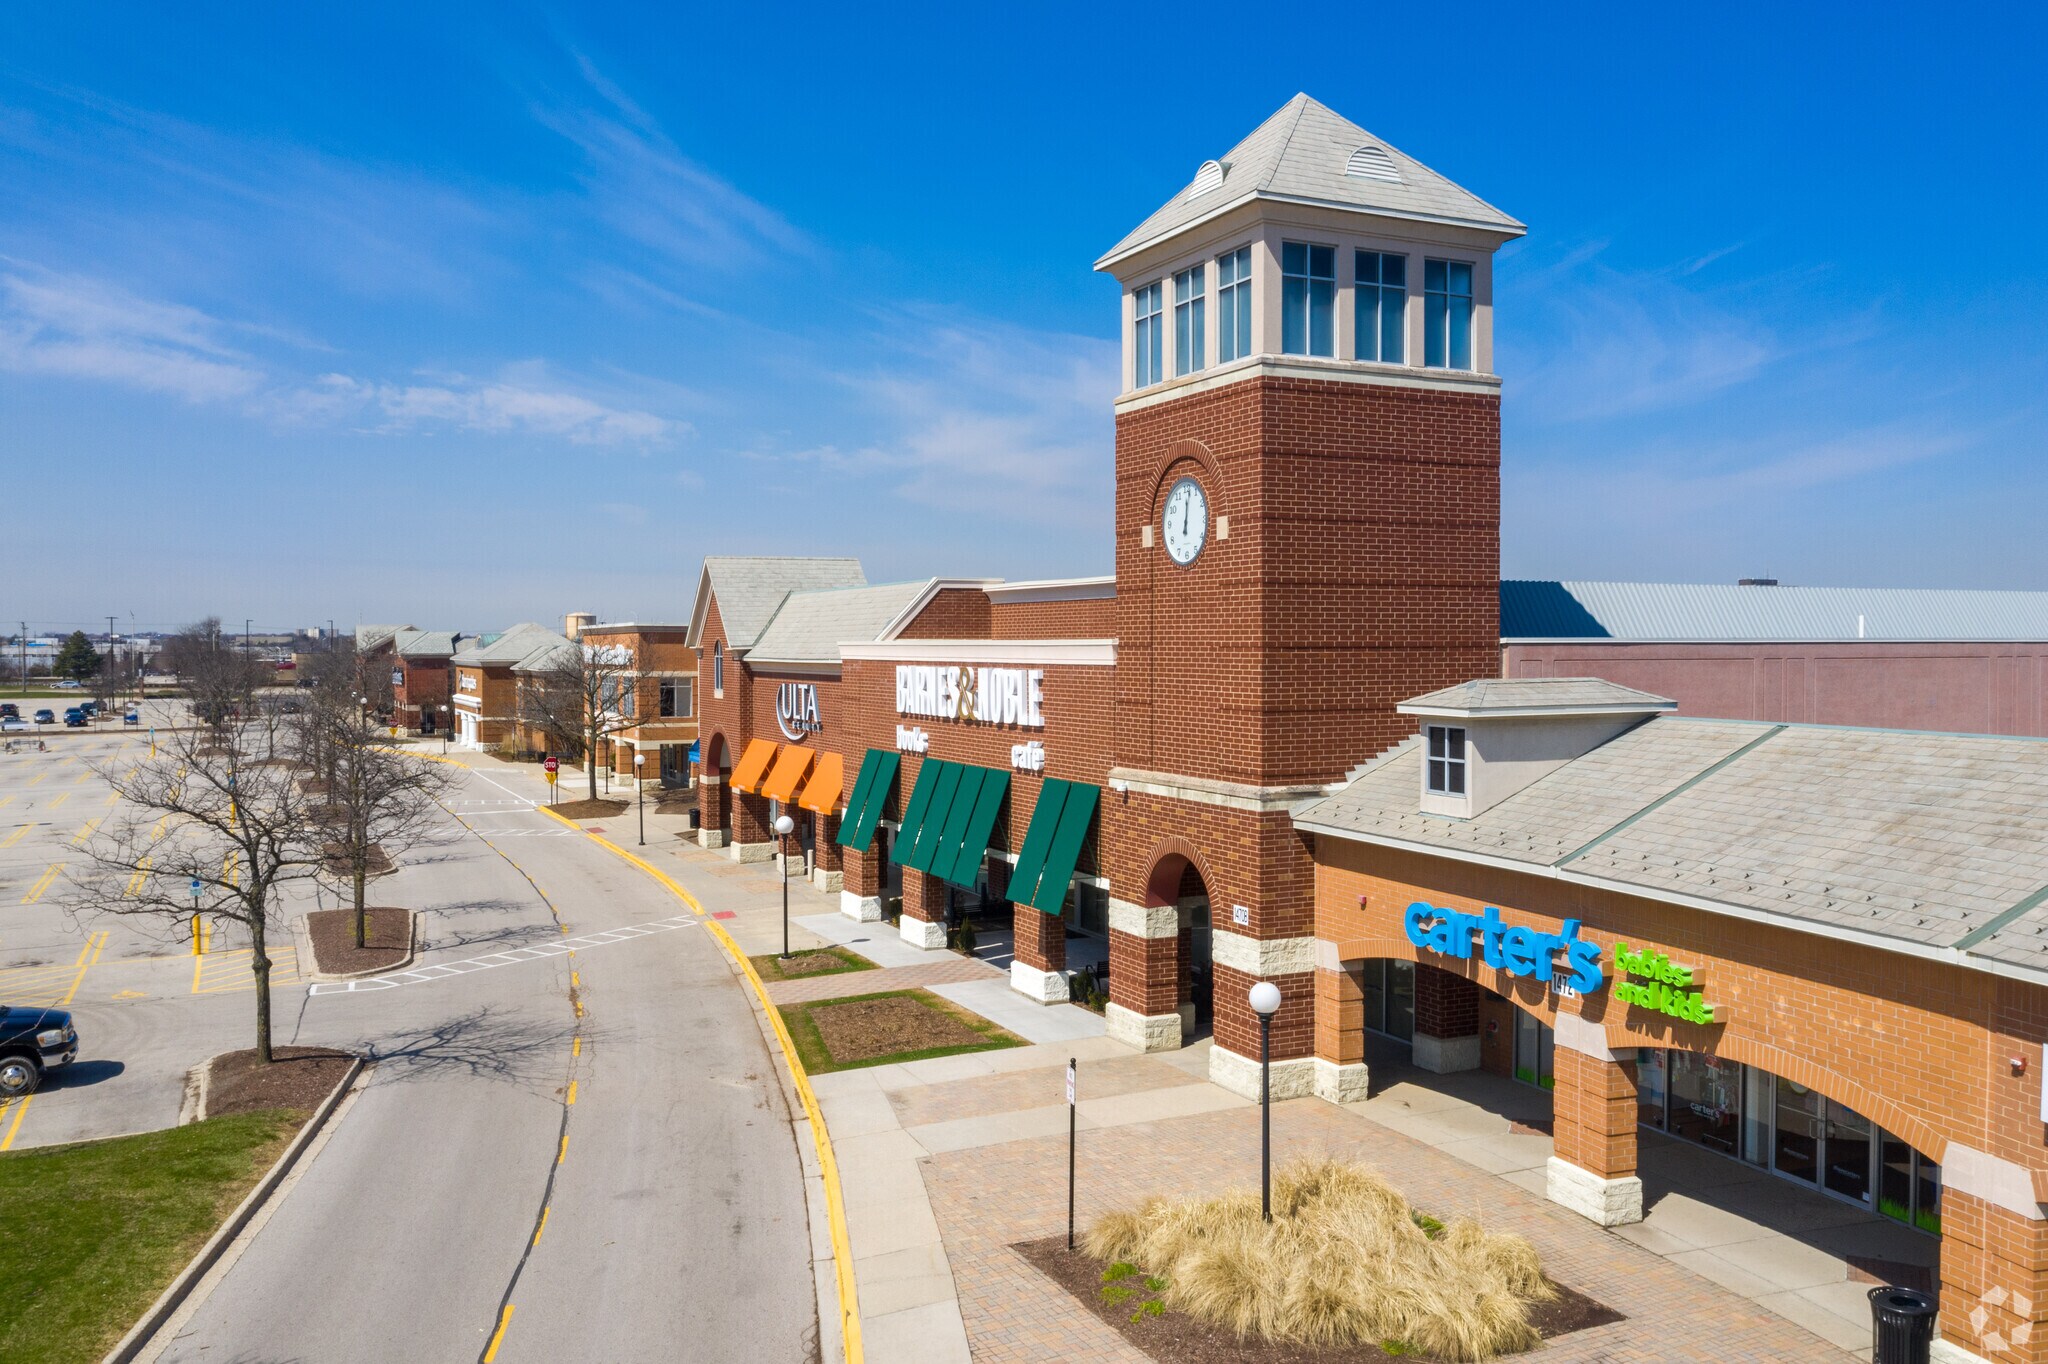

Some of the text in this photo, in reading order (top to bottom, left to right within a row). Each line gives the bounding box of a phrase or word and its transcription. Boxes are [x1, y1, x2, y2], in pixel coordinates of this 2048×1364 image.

[1175, 492, 1181, 501] 11
[1170, 505, 1176, 514] 10
[1168, 521, 1172, 529] 9
[1170, 536, 1174, 545] 8
[1177, 548, 1181, 556] 7
[1185, 551, 1189, 559] 6
[781, 683, 821, 722] ULTA
[896, 724, 929, 753] books
[1404, 901, 1603, 994] carter's
[1615, 942, 1694, 987] babies
[1614, 982, 1715, 1025] and kids
